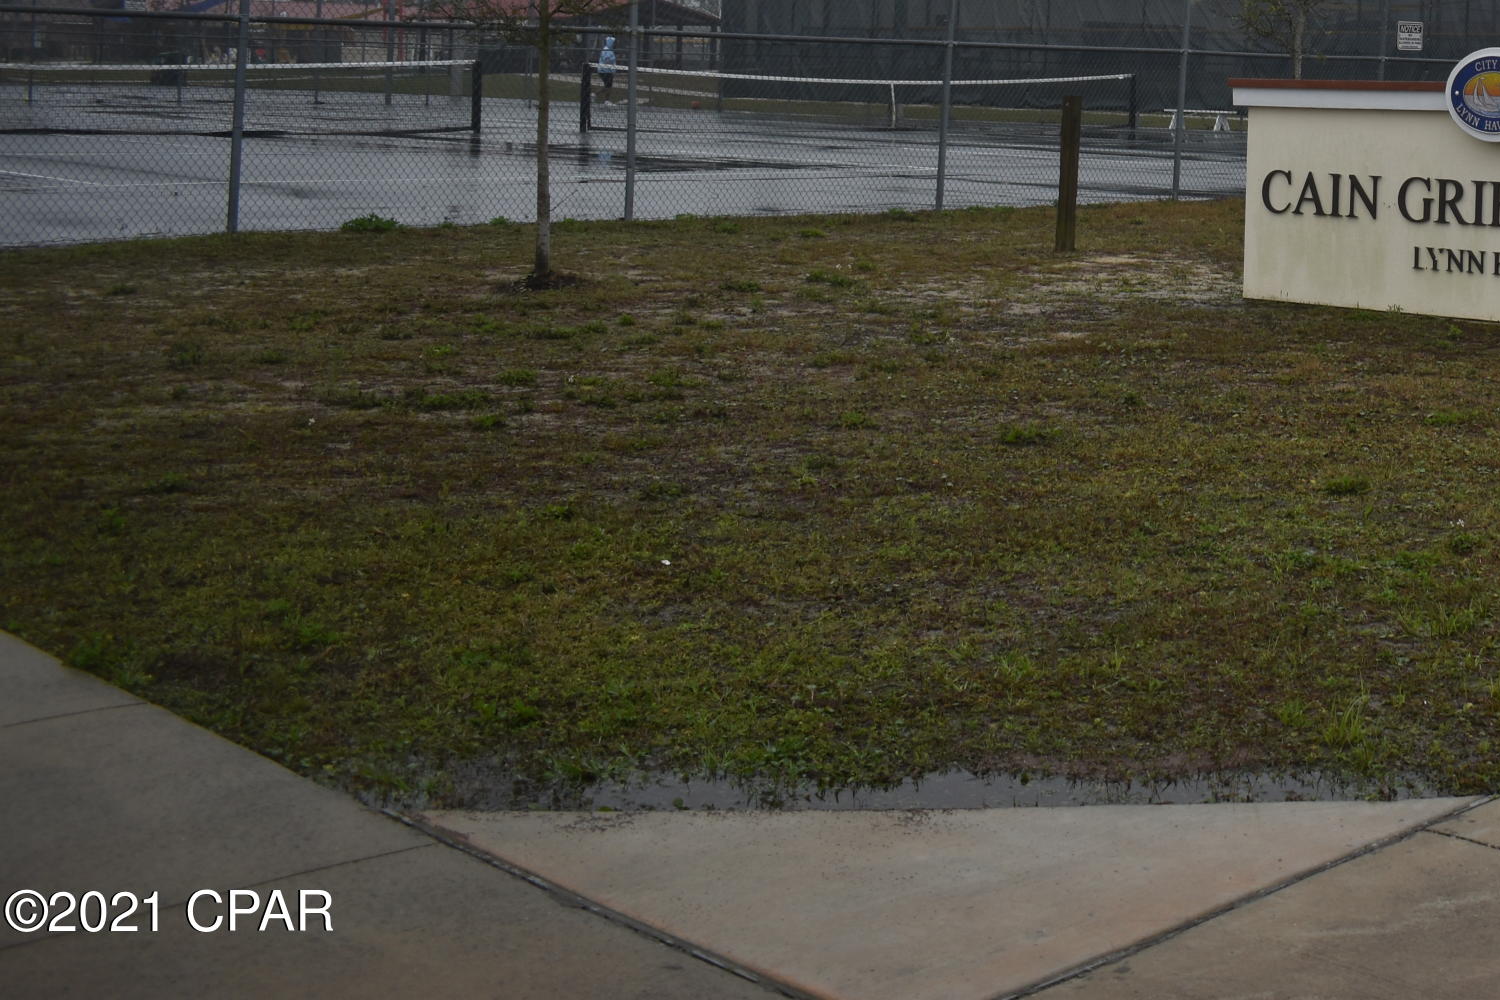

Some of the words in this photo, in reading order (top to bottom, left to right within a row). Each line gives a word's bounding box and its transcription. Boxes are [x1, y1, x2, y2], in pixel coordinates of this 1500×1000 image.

[1400, 25, 1421, 33] NOTICE
[1475, 60, 1498, 72] CITY
[1456, 103, 1480, 127] LYNN
[1261, 169, 1382, 220] CAIN
[1412, 246, 1485, 275] LYNN
